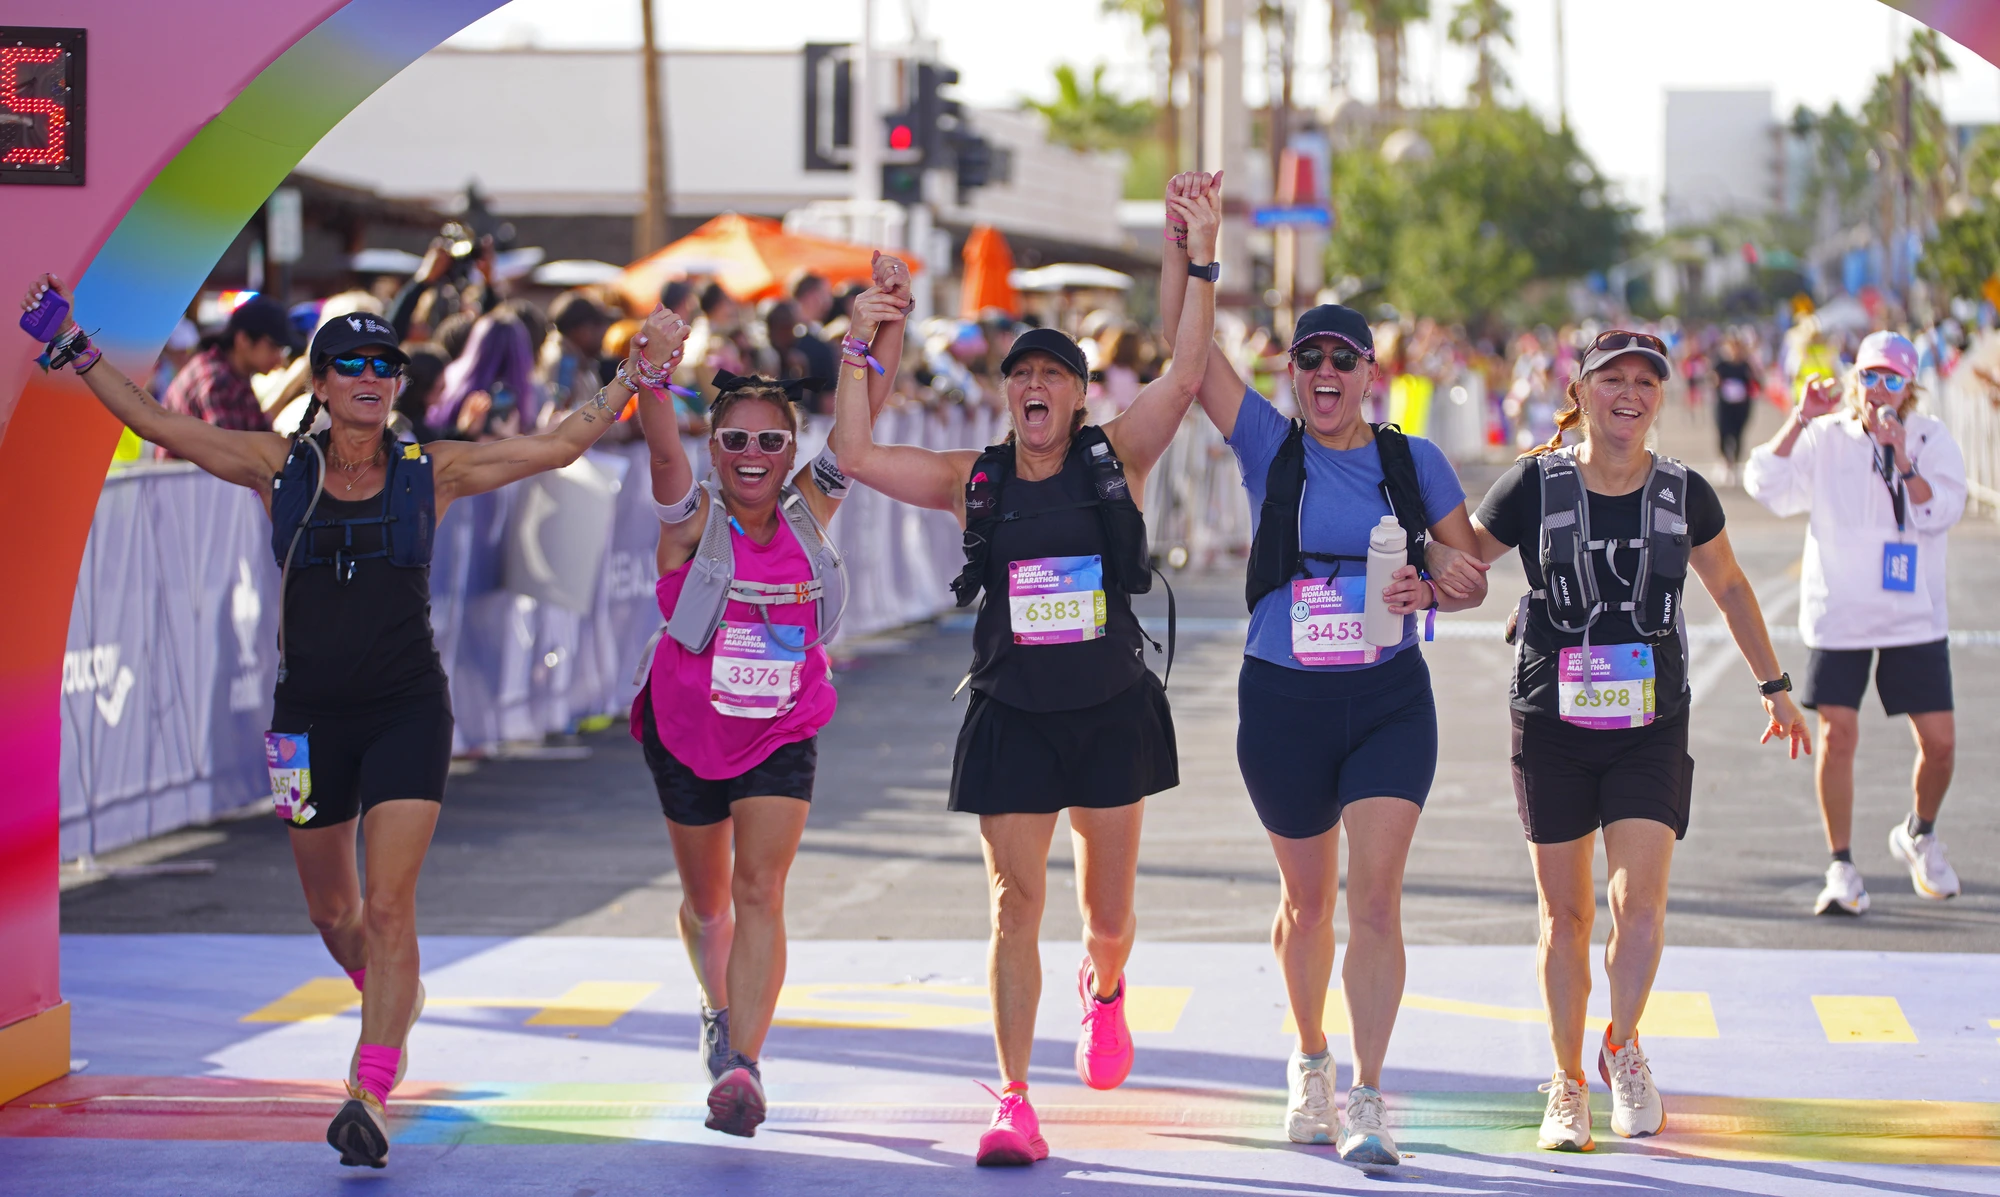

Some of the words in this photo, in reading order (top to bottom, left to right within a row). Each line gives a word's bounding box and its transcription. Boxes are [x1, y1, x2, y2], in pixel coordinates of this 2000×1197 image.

[0, 47, 65, 164] 5
[1018, 564, 1042, 572] EVERY
[1018, 570, 1054, 578] WOMAN'S
[1016, 576, 1060, 584] MARATHON
[1302, 584, 1324, 592] EVERY
[1302, 590, 1337, 598] WOMAN'S
[1025, 600, 1081, 622] 6383
[1096, 596, 1105, 620] ELYSE
[1663, 592, 1671, 624] AONIJIE
[726, 633, 762, 642] WOMAN'S
[1307, 621, 1363, 641] 3453
[724, 640, 766, 648] MARATHON
[728, 666, 780, 686] 3376
[792, 664, 803, 692] SARAH
[1574, 689, 1630, 708] 6398
[240, 976, 2000, 1045] INISH
